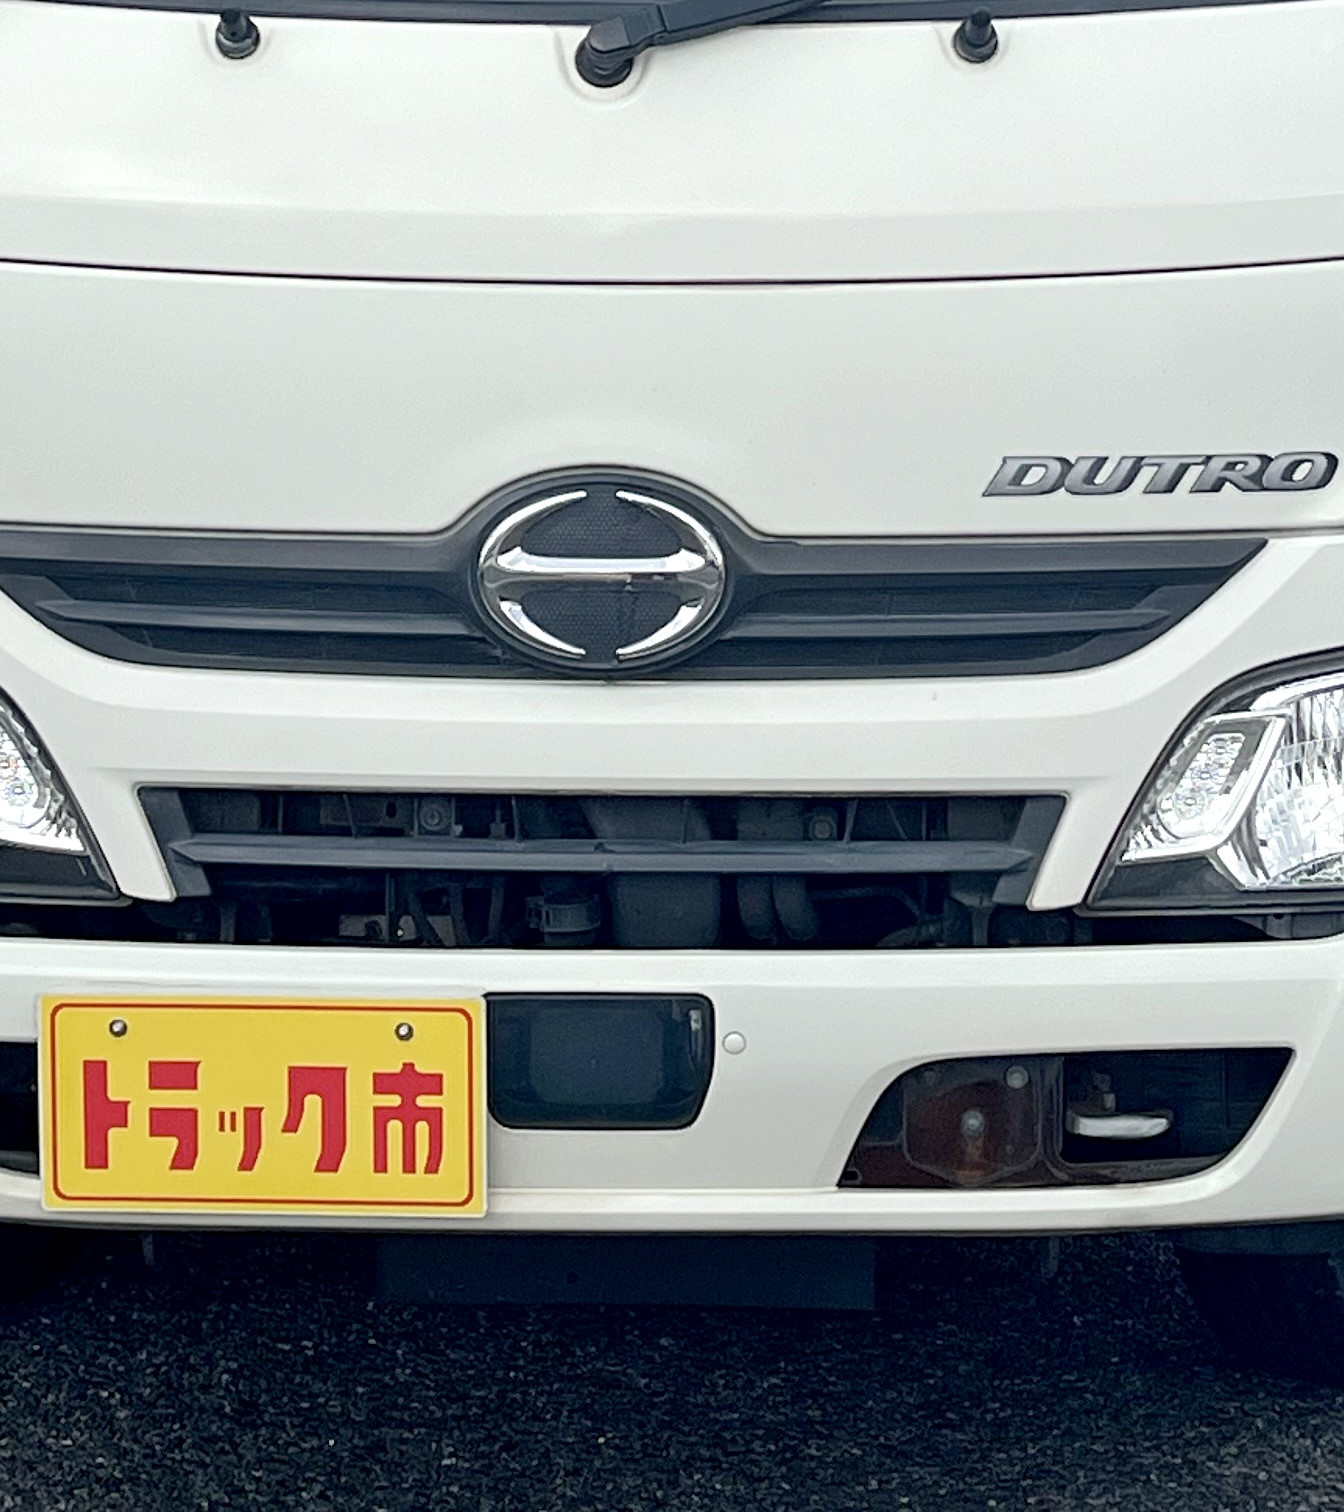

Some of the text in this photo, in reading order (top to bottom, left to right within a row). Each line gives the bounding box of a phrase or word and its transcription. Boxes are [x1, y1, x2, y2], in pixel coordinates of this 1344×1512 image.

[982, 452, 1340, 497] DUTRO
[83, 1060, 444, 1175] トラック市
